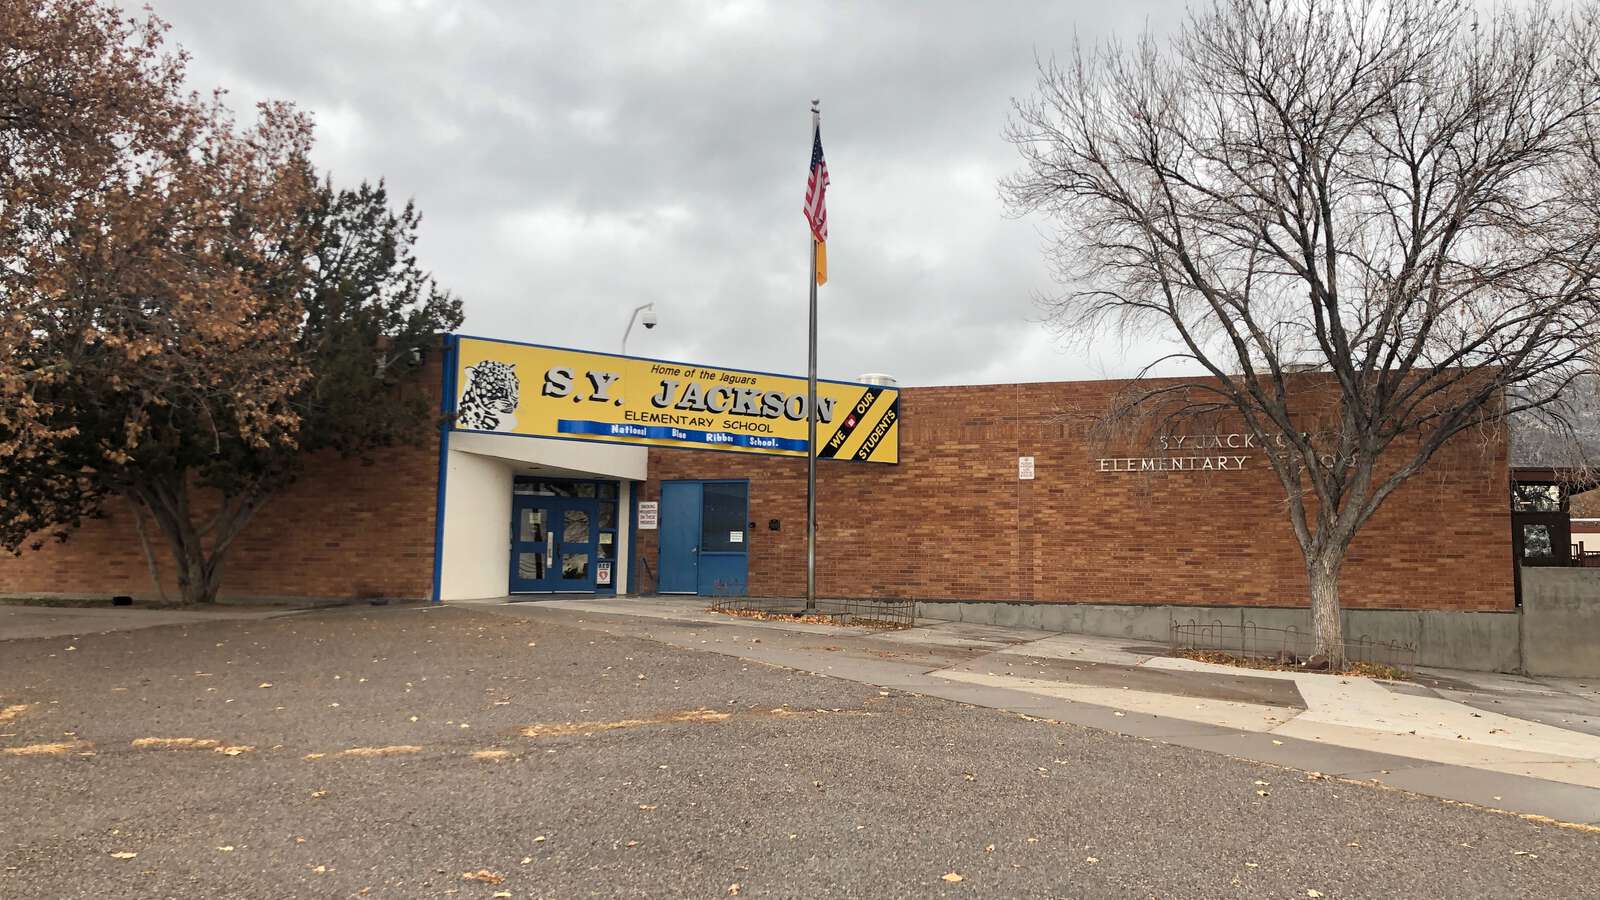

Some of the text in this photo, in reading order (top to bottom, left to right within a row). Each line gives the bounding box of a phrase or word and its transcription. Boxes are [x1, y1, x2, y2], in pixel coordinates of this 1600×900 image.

[651, 364, 757, 384] Home of the Jaguars
[542, 366, 838, 424] S.Y. JACKSON
[625, 410, 773, 433] ELEMENTARY SCHOOL
[830, 392, 874, 448] WE OUR
[859, 409, 896, 459] STUDENTS
[1100, 456, 1246, 471] ELEMENTARY
